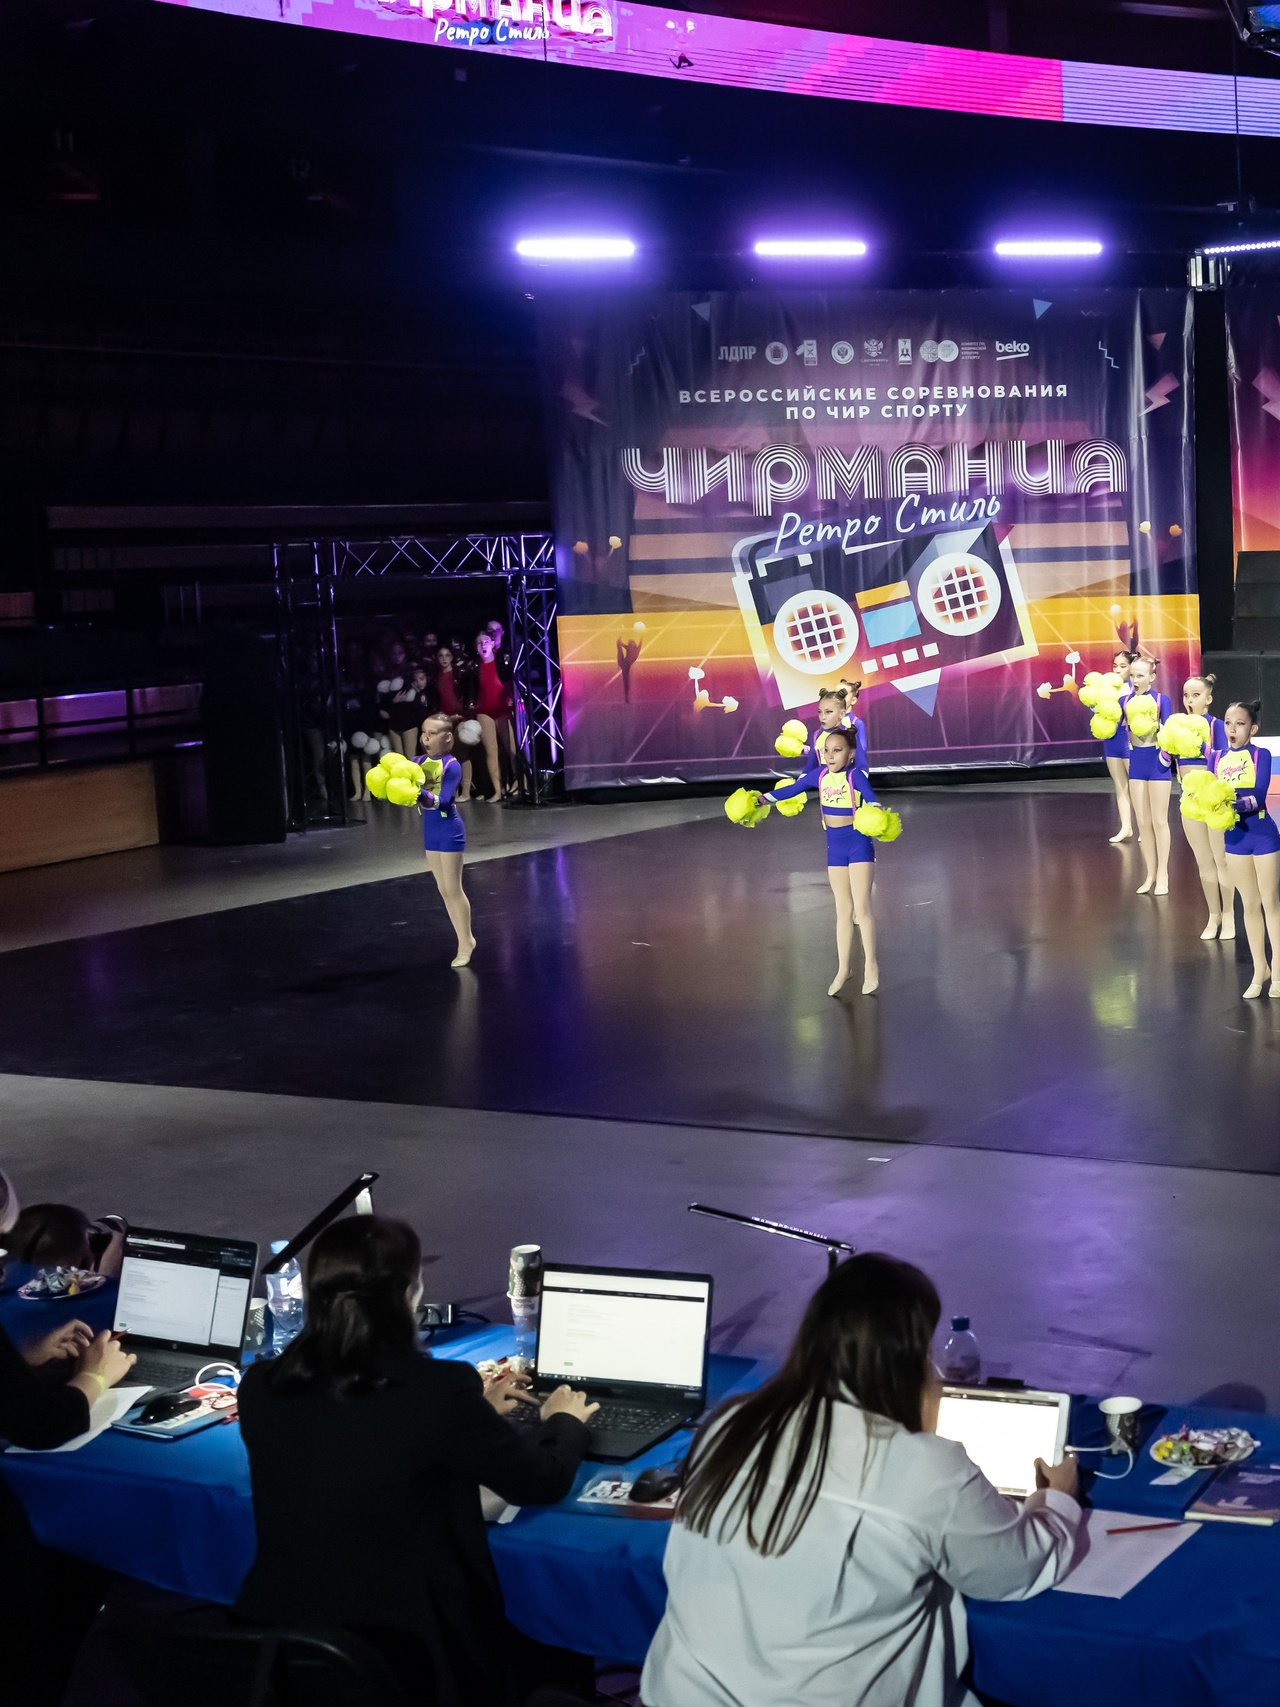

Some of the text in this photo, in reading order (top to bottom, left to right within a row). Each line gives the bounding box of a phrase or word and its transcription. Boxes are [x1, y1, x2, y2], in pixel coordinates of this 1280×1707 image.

[434, 17, 549, 46] Ретро Стиль
[718, 346, 757, 362] ЛДПР
[995, 340, 1030, 353] beko
[678, 383, 1069, 404] ВСЕРОССИЙСКИЕ СОРЕВНОВАНИЯ
[785, 402, 968, 420] ПО ЧИР СПОРТУ
[774, 493, 1001, 552] Ретро Стиль
